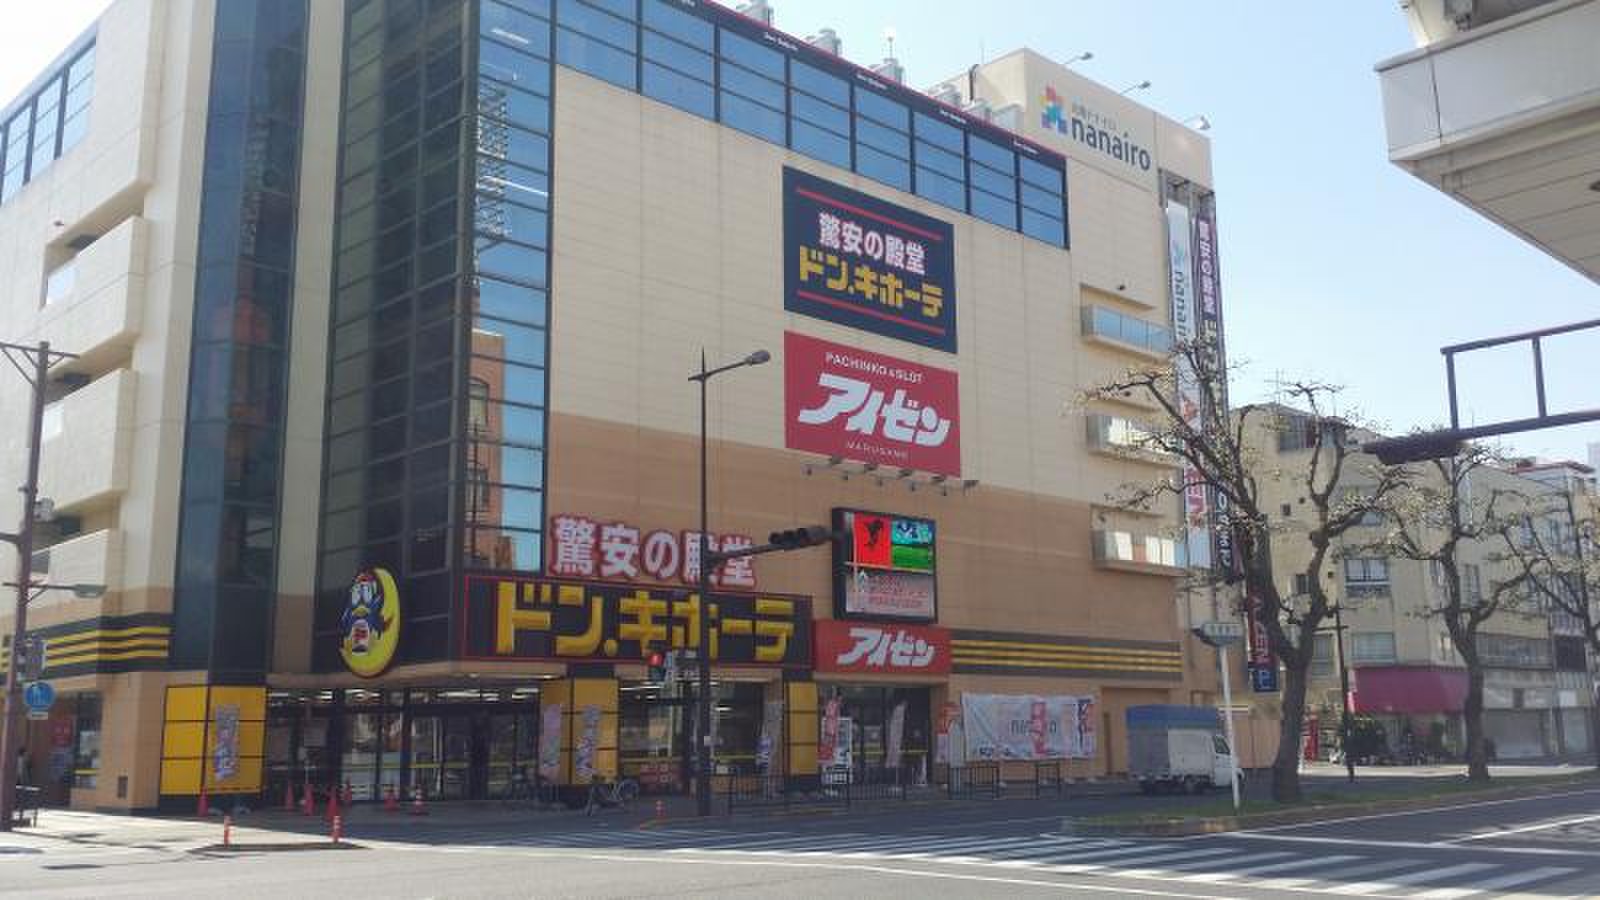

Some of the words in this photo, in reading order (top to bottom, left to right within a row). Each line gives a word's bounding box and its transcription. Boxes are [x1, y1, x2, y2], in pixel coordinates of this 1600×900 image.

[1072, 117, 1151, 171] nanairo
[817, 211, 926, 276] 驚安の殿堂
[552, 515, 756, 588] 驚安の殿堂
